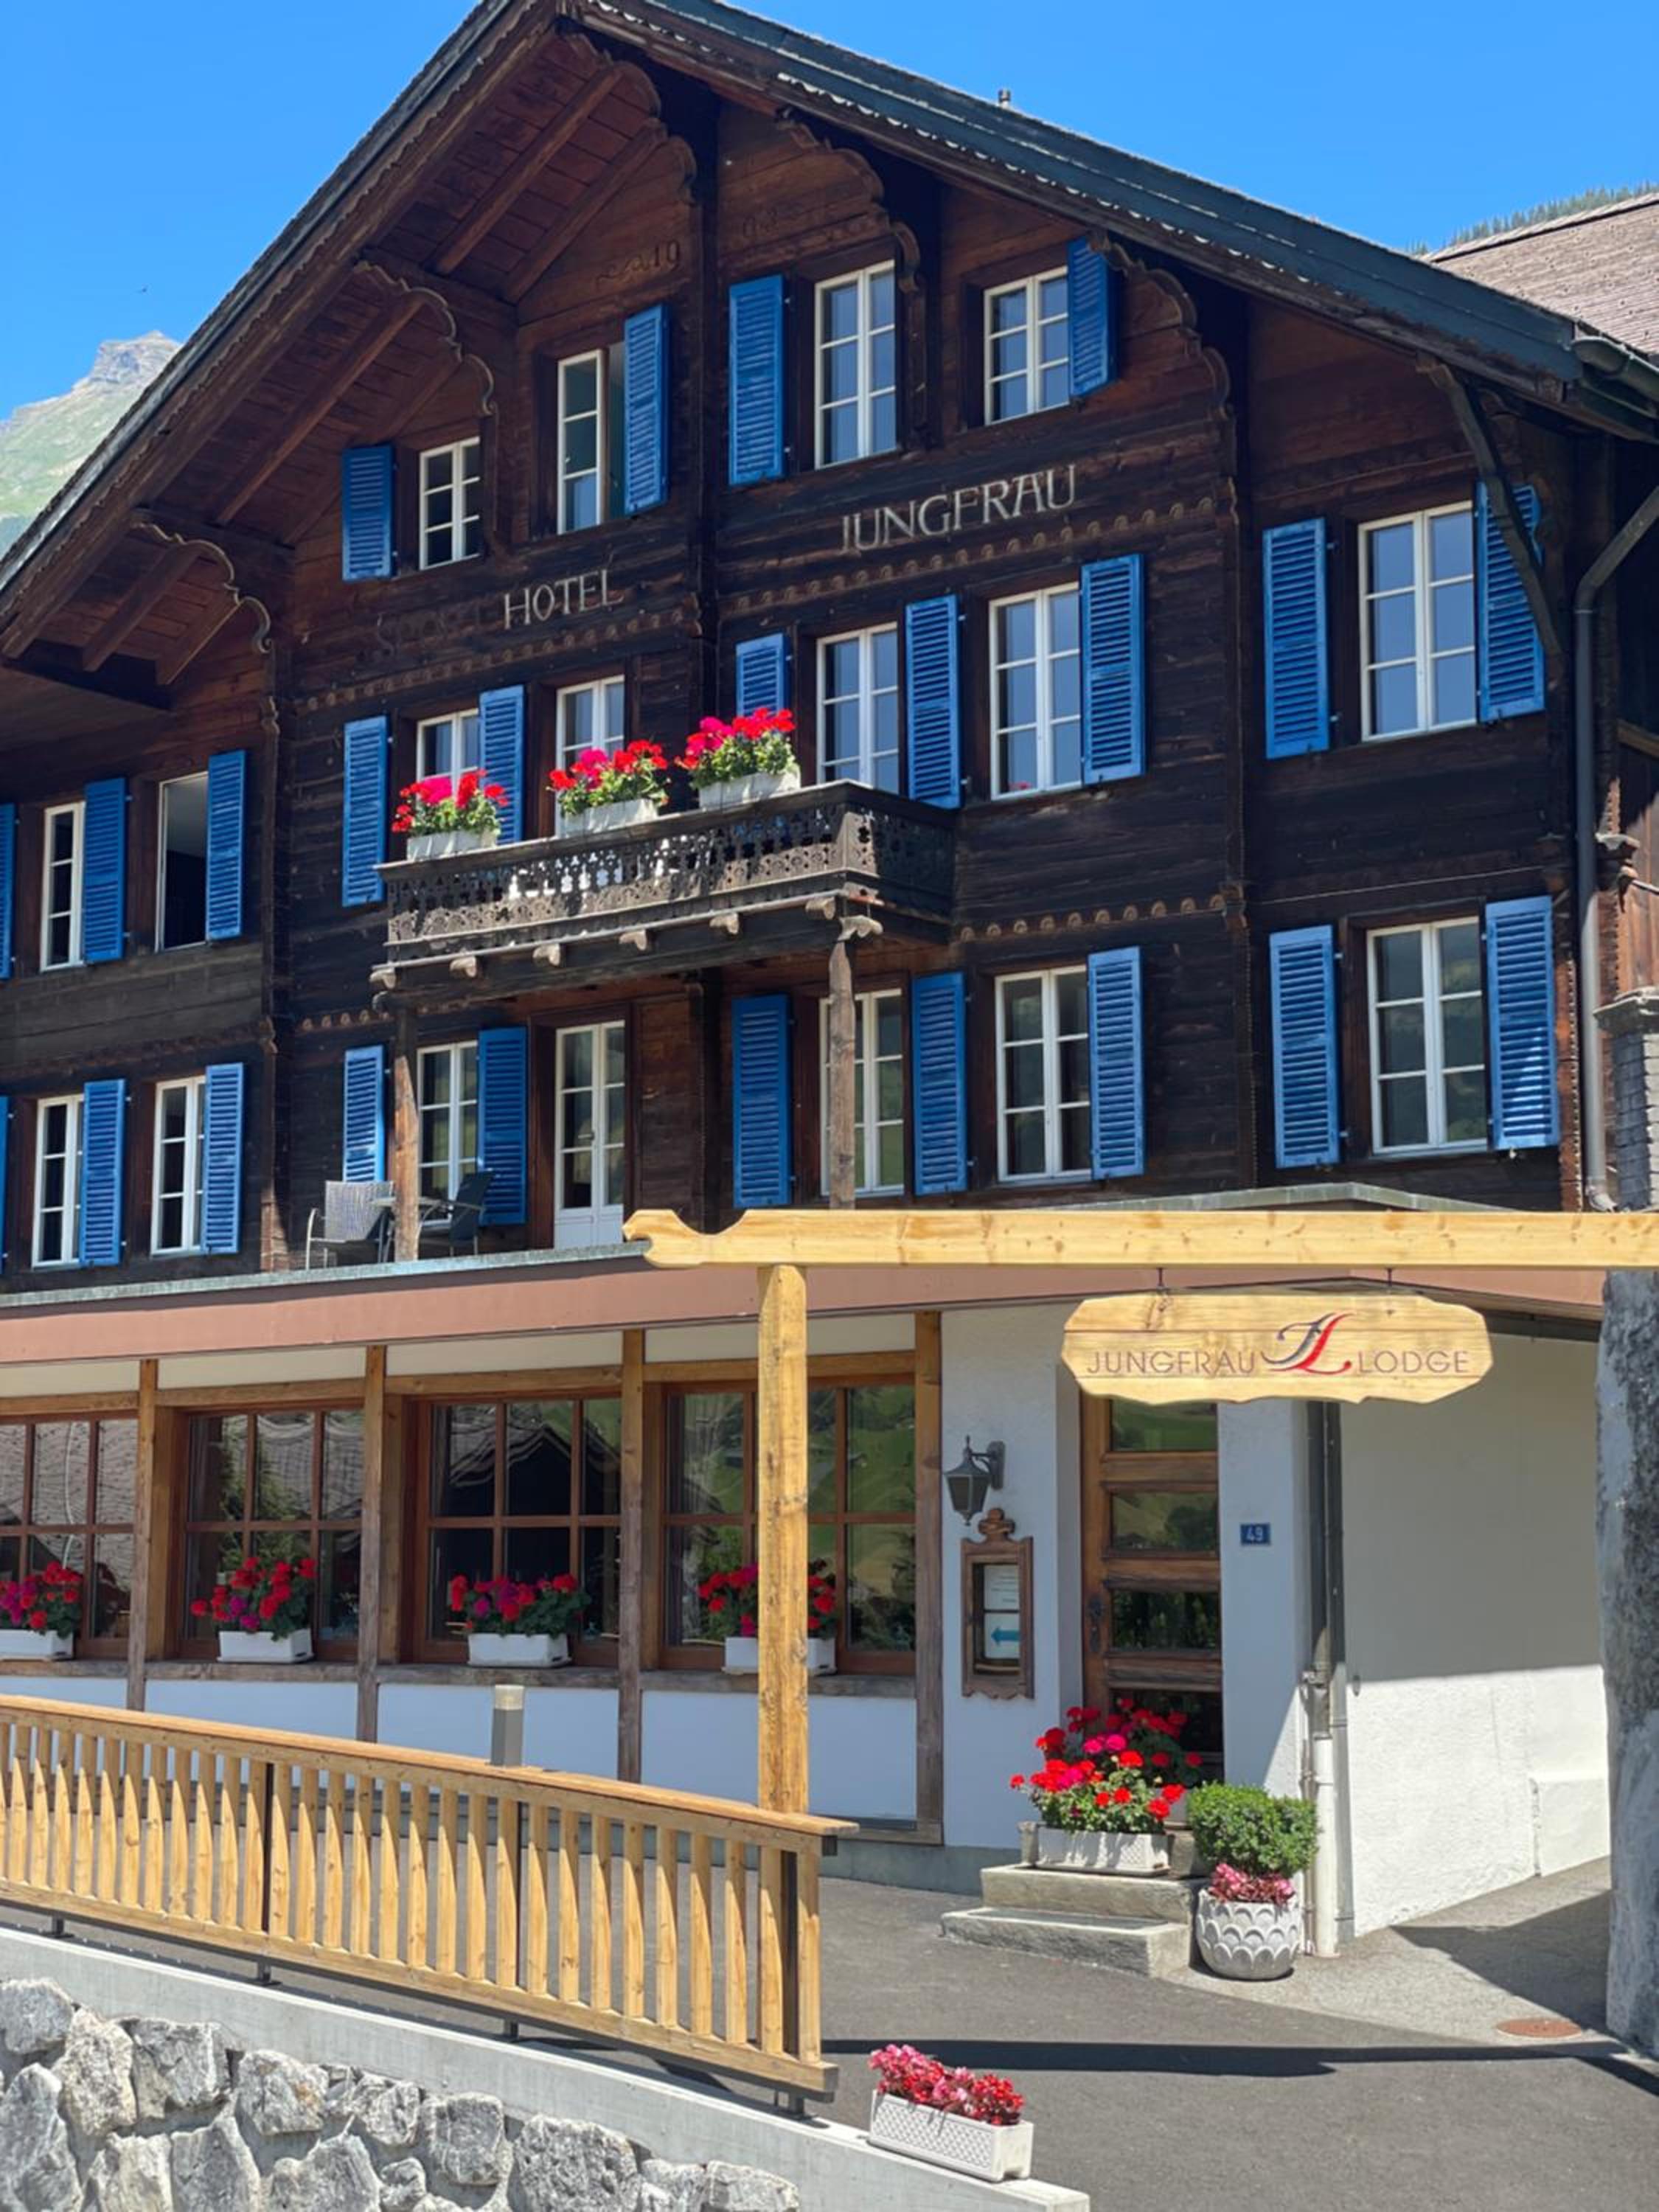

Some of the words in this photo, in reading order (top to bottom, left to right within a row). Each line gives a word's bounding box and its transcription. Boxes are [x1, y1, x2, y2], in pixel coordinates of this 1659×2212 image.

[504, 568, 624, 630] HOTEL
[841, 464, 1077, 554] JUNGFRAU
[1087, 1350, 1255, 1374] JUNGFRAU
[1359, 1350, 1467, 1374] LODGE
[1245, 1526, 1263, 1543] 49
